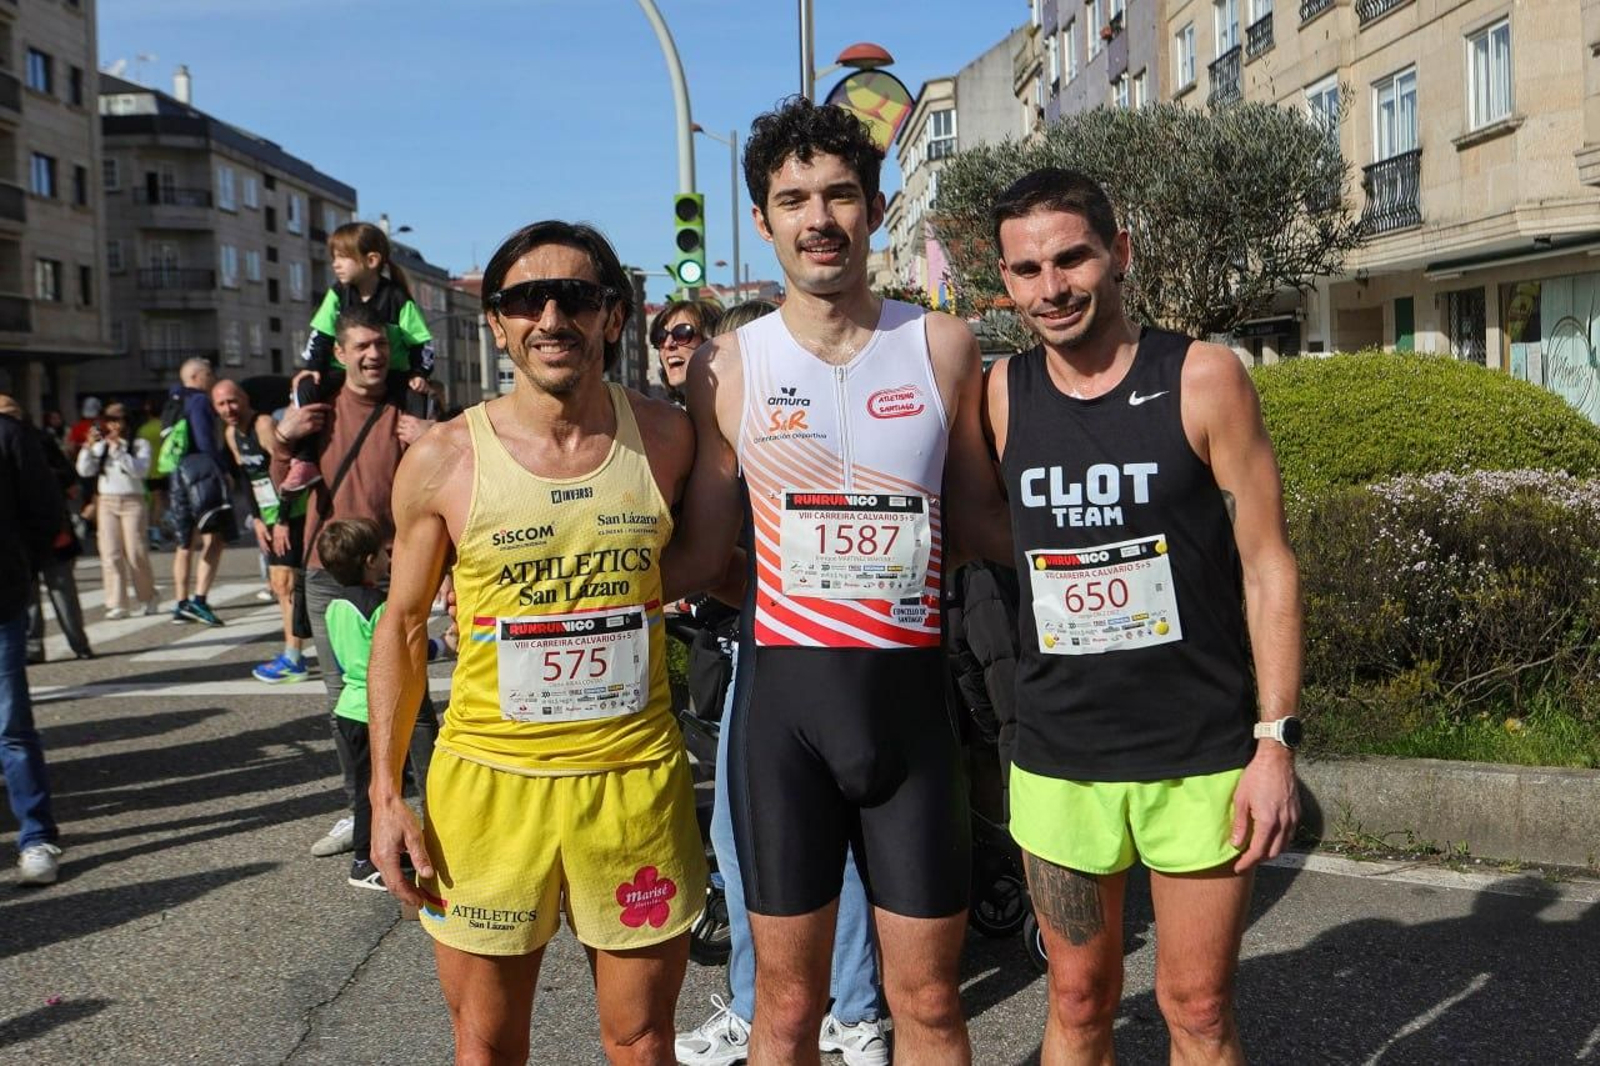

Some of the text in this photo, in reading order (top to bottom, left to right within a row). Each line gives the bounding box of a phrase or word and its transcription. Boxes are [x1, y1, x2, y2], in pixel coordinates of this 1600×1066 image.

[767, 396, 810, 407] amura
[879, 402, 915, 413] SANTIAGO
[1020, 462, 1158, 508] CLOT
[597, 514, 620, 526] San
[814, 512, 855, 521] CARREIRA
[856, 512, 898, 522] CALVARIO
[1051, 506, 1124, 528] TEAM
[814, 523, 900, 556] 1587
[498, 547, 652, 586] ATHLETICS
[1091, 562, 1134, 577] CALVARIO
[519, 584, 557, 607] San
[1065, 577, 1129, 613] 650
[530, 638, 574, 649] CARREIRA
[574, 634, 617, 646] CALVARIO
[543, 646, 608, 682] 575
[451, 904, 538, 923] ATHLETICS
[469, 920, 485, 929] San
